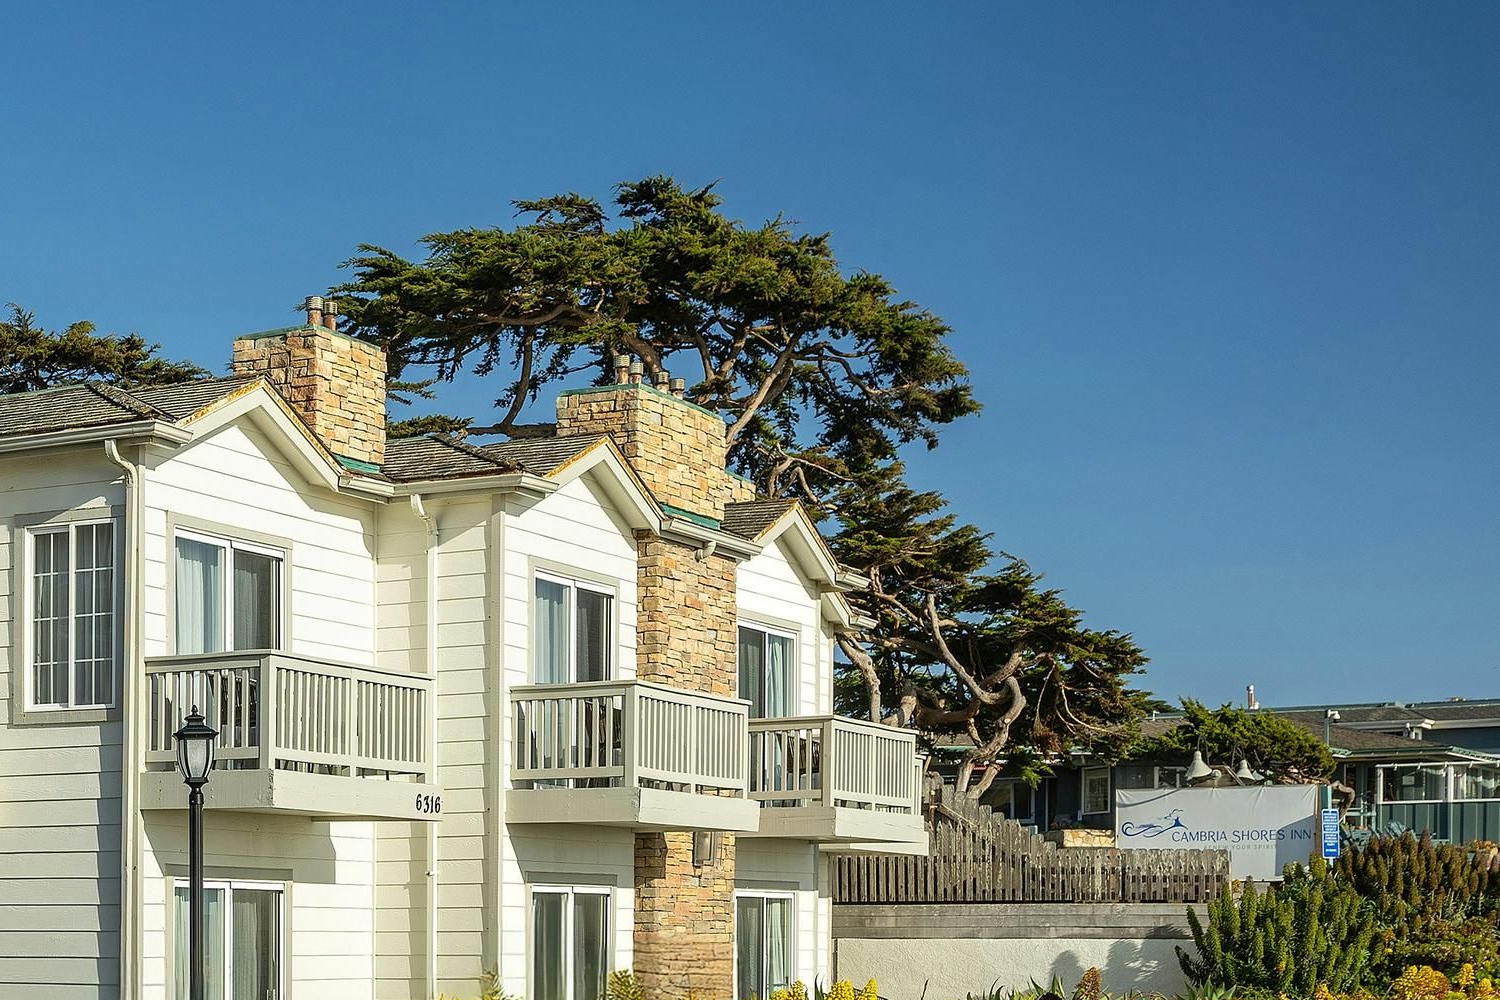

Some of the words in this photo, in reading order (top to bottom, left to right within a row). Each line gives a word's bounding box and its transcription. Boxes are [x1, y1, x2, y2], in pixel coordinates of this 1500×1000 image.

[415, 793, 441, 814] 6316
[1171, 830, 1228, 843] CAMBRIA
[1231, 829, 1286, 844] SHORES
[1290, 829, 1312, 840] INN
